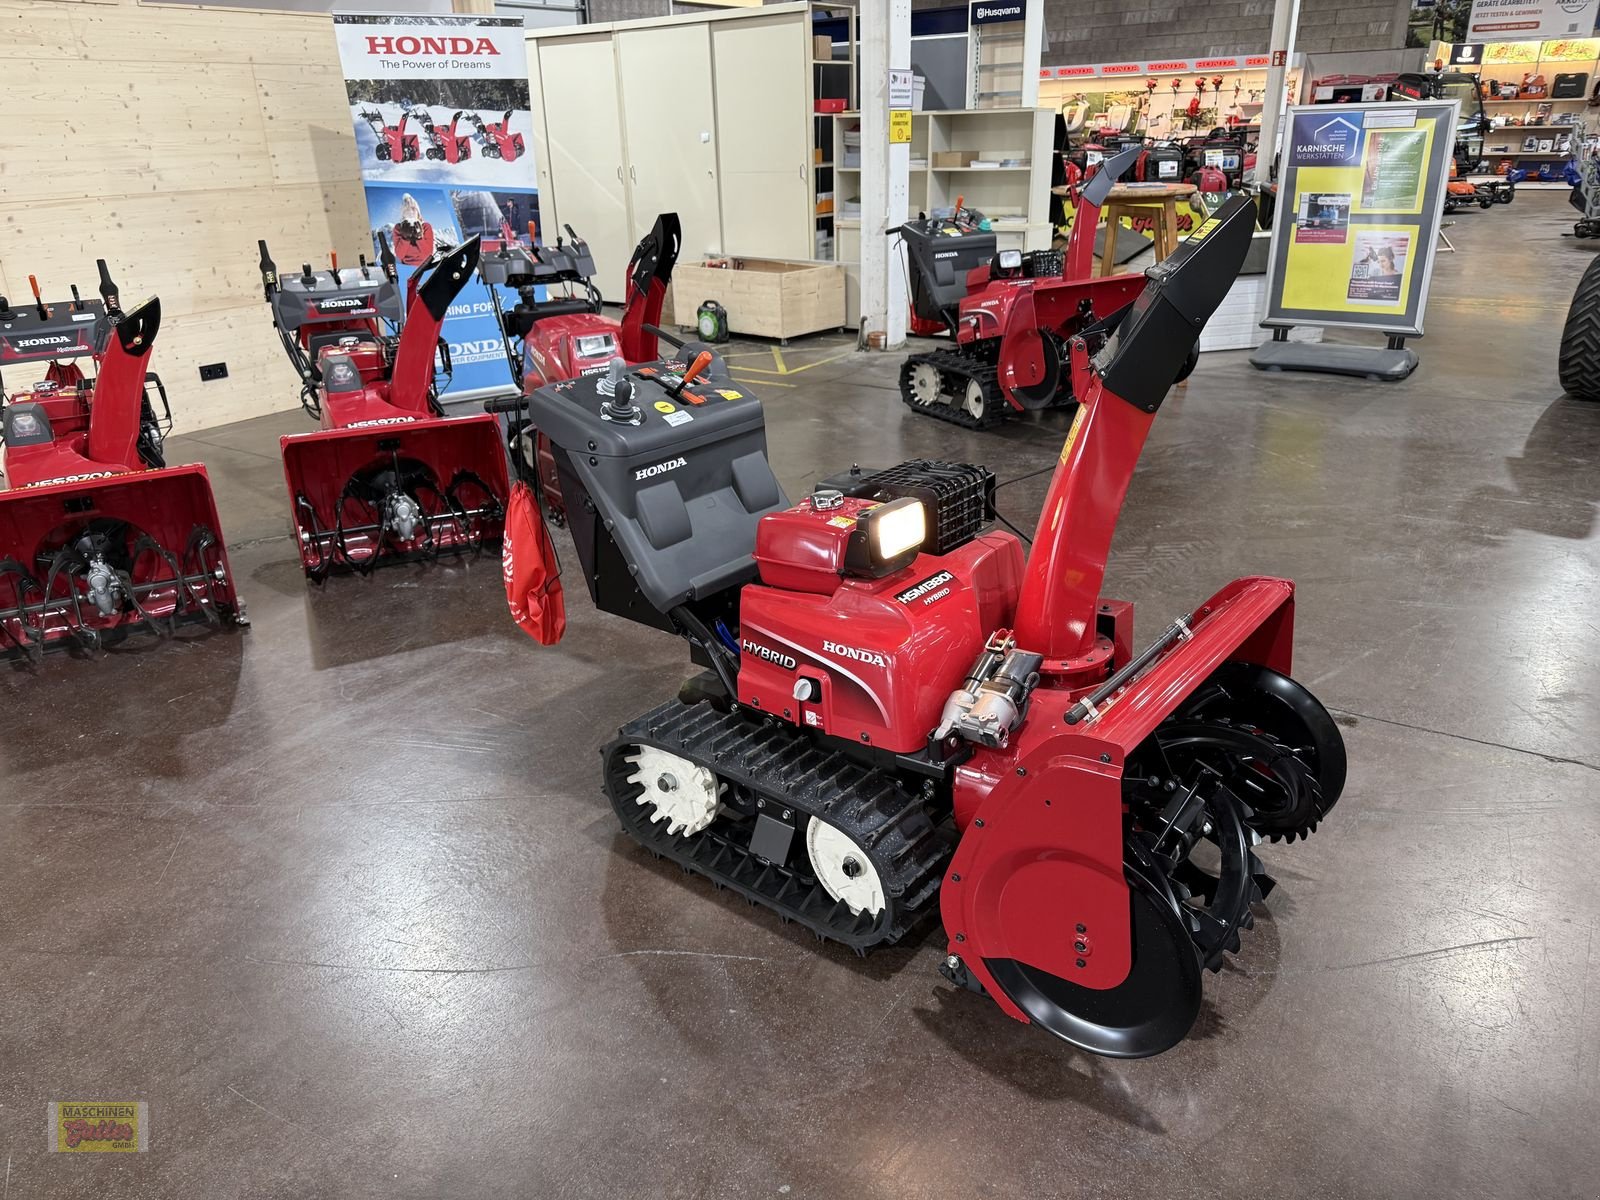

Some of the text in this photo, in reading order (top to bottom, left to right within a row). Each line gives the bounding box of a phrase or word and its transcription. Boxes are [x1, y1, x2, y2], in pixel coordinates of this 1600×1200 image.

[985, 7, 1020, 17] Husqvarna
[365, 36, 501, 55] HONDA
[379, 59, 491, 69] The Power of Dreams
[1195, 58, 1237, 69] HONDA
[1245, 57, 1269, 66] HON
[1102, 65, 1140, 74] HONDA
[1148, 62, 1187, 72] HONDA
[1296, 144, 1345, 153] KARNISCHE
[935, 251, 958, 259] HONDA
[320, 299, 362, 309] HONDA
[981, 299, 1000, 308] HONDA
[18, 336, 71, 347] HONDA
[635, 456, 688, 481] HONDA
[923, 587, 950, 606] HYBRID
[743, 639, 797, 669] HYBRID
[822, 640, 886, 668] HONDA
